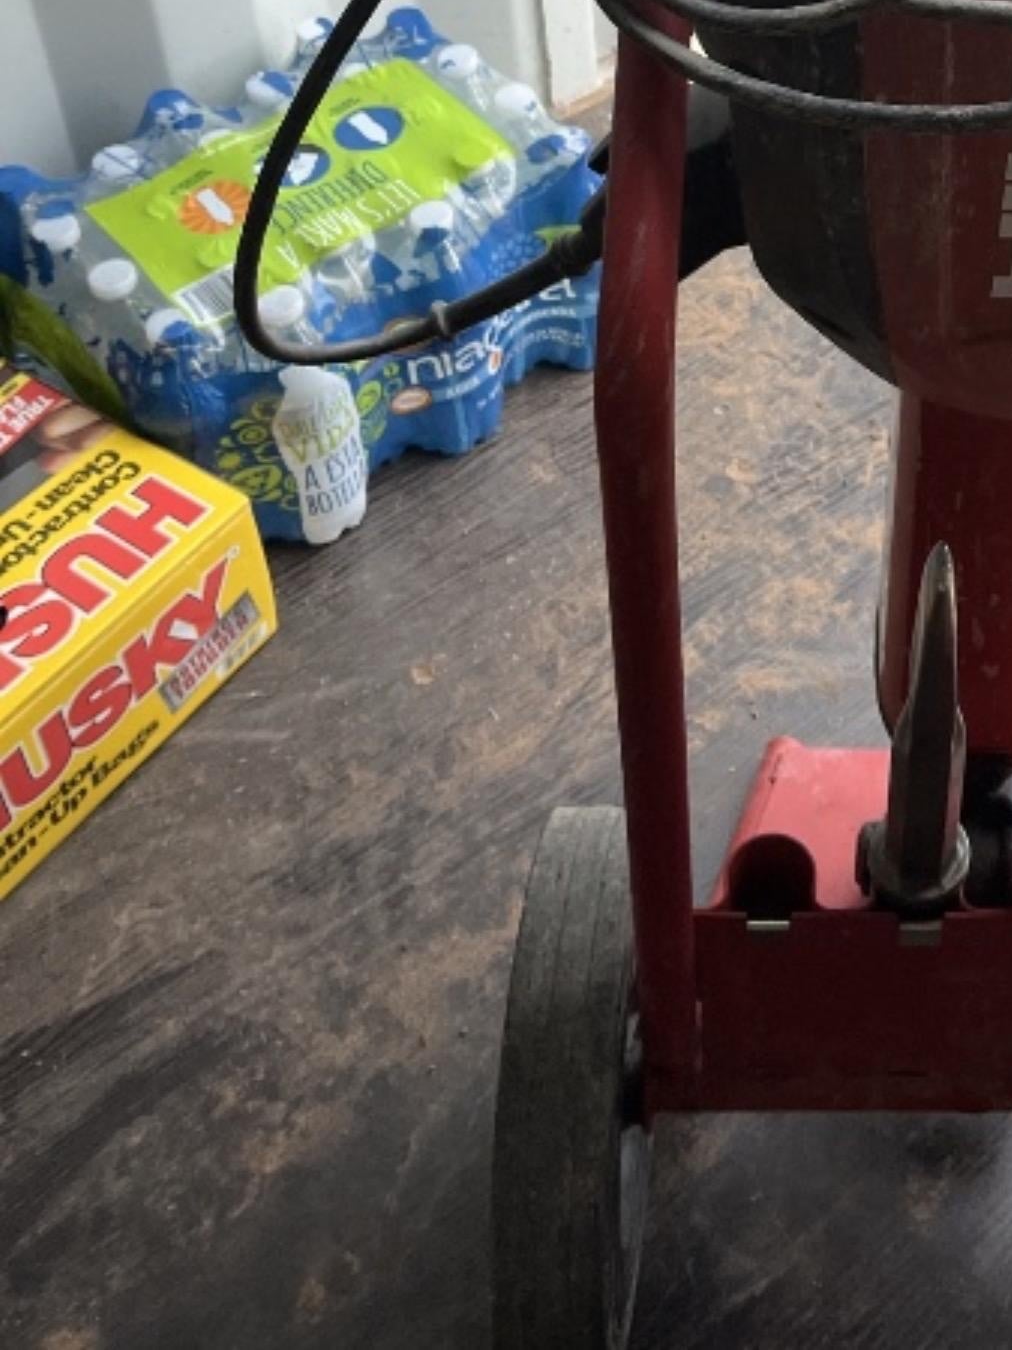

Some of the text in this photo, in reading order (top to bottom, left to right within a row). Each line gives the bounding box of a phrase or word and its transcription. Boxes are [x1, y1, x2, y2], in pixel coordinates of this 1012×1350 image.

[407, 278, 577, 385] niaga
[0, 461, 142, 575] Contracto
[0, 475, 211, 691] HUS
[0, 556, 229, 833] USKY
